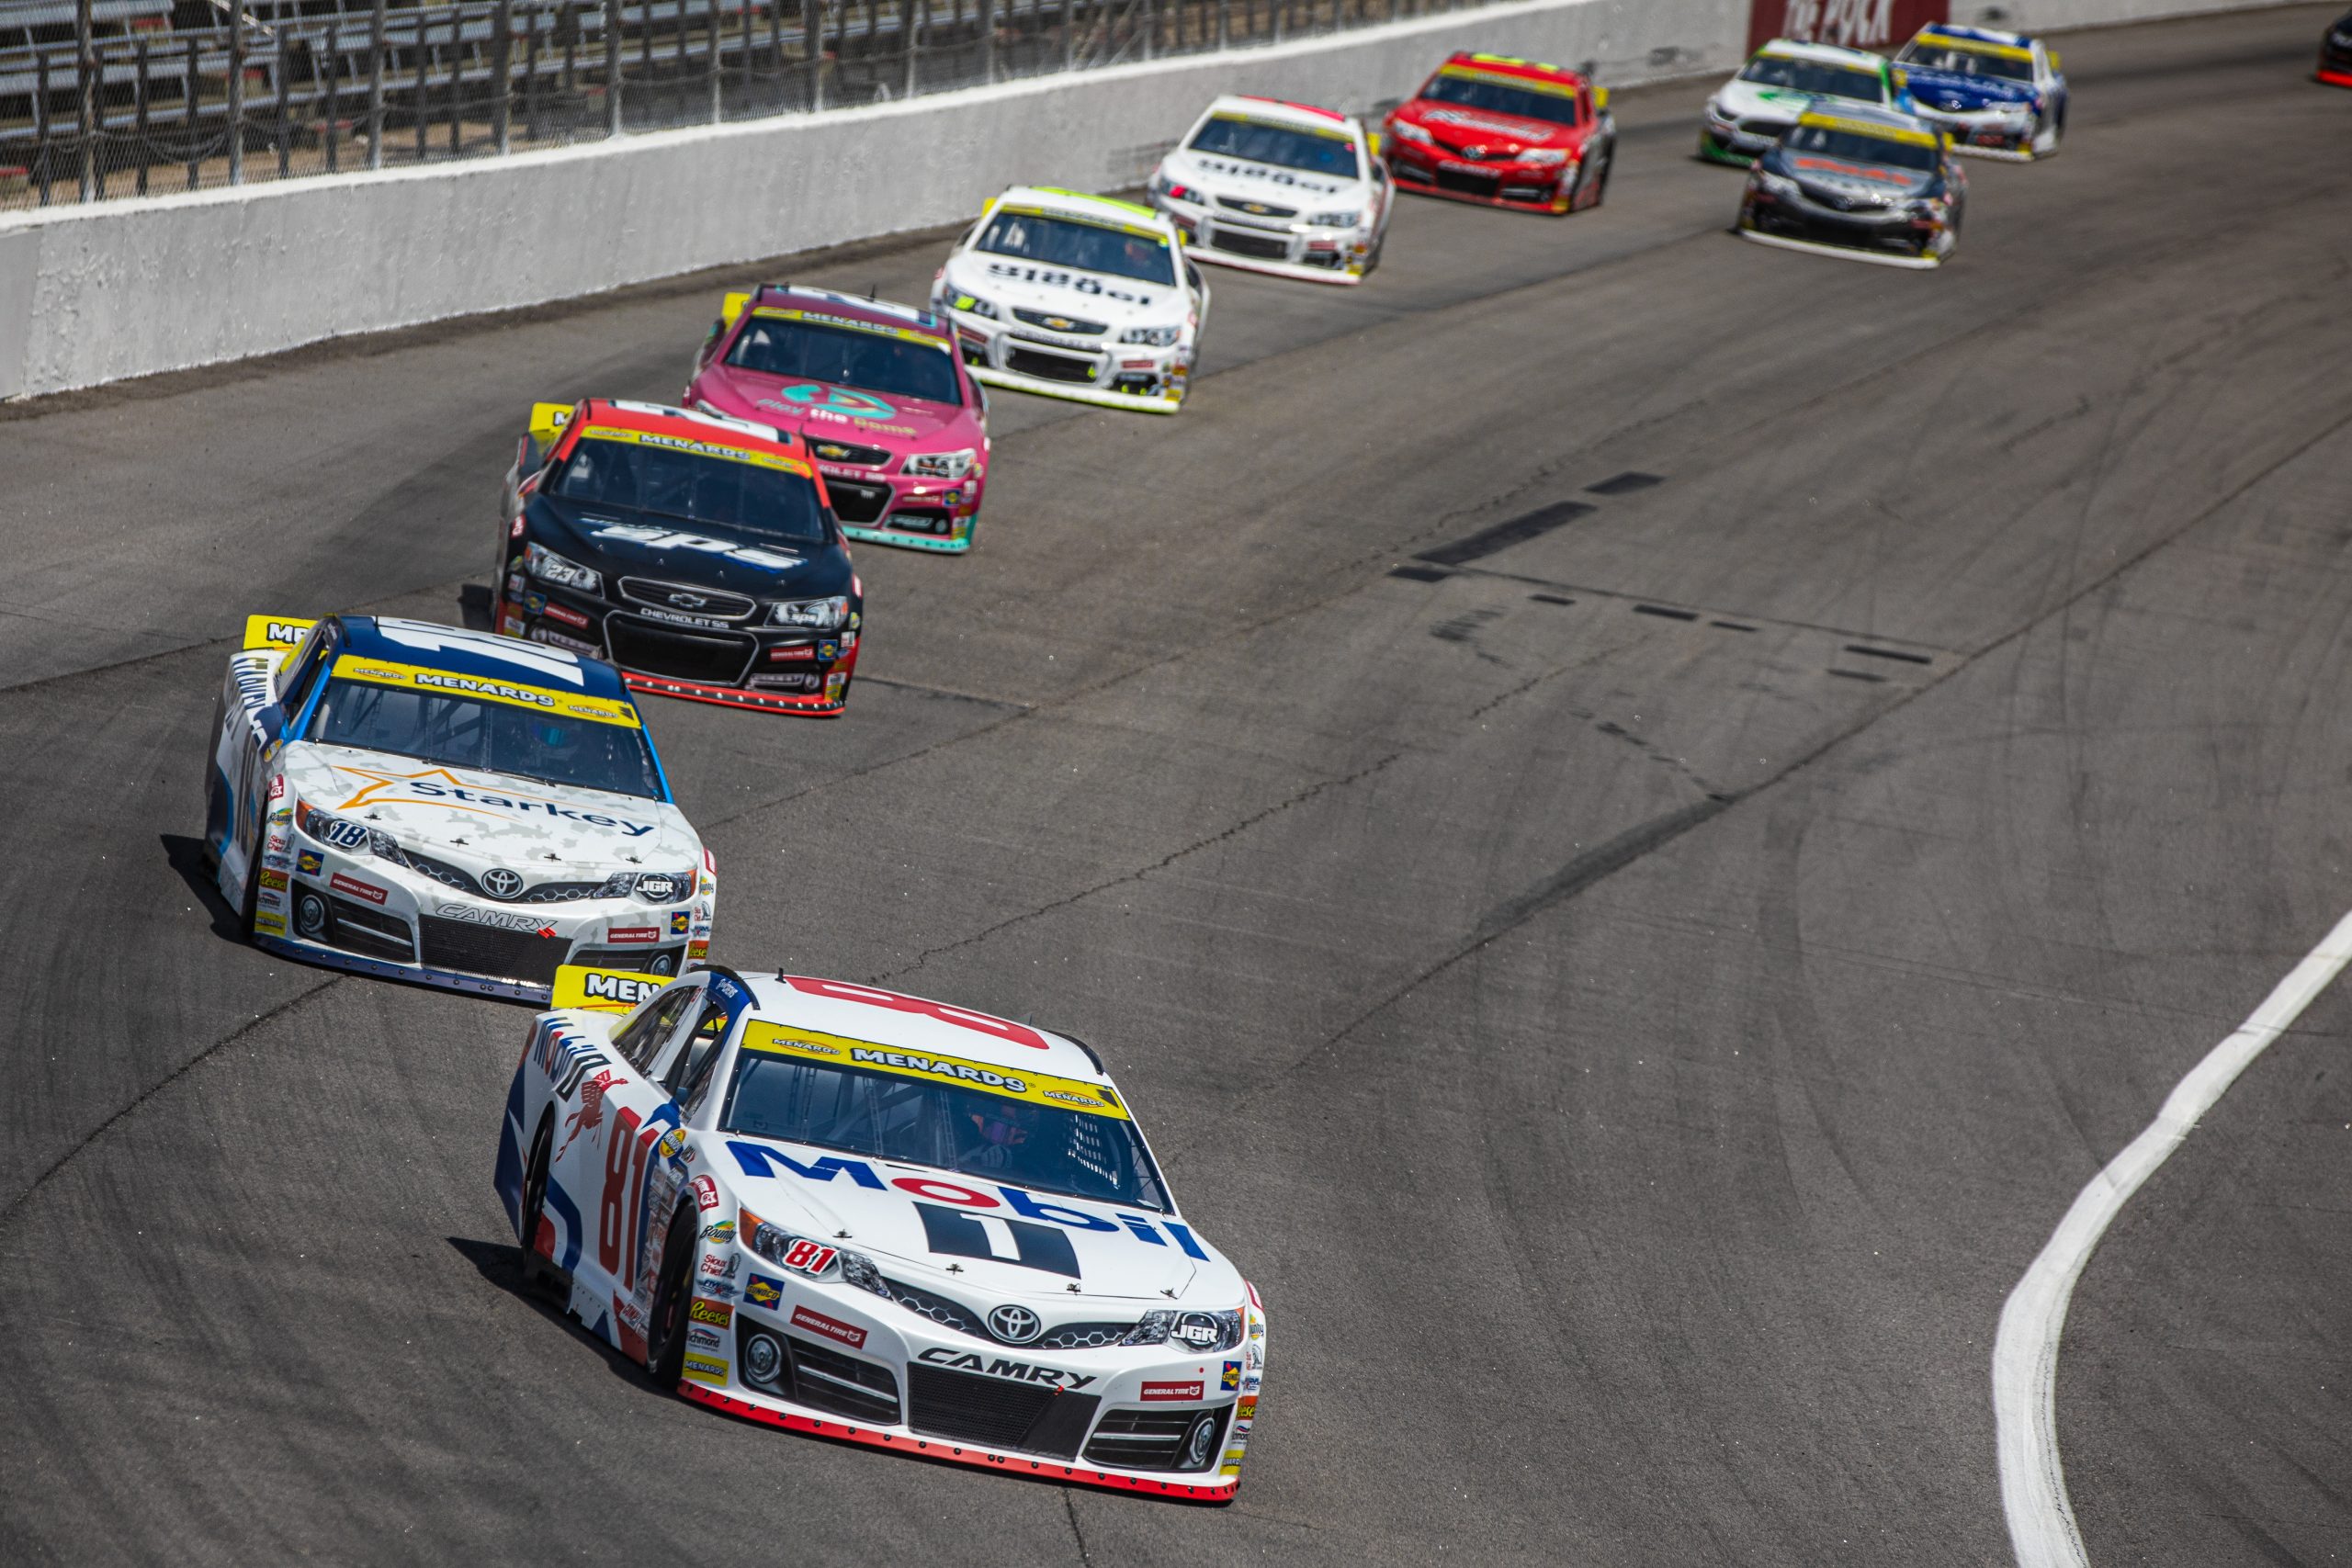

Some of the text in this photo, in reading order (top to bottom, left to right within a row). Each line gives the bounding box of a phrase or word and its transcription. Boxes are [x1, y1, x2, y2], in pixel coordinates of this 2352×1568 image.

[639, 434, 751, 460] MENARDS
[639, 607, 729, 629] CHEVROLET SS
[414, 672, 556, 707] MENARDS
[410, 782, 655, 837] Starkey
[326, 821, 368, 848] 18
[635, 880, 674, 893] JGR
[435, 903, 559, 932] CAMRY
[585, 974, 662, 1002] MEN
[772, 1038, 841, 1055] MENARDS
[852, 1046, 1027, 1093] MENARDS
[1044, 1089, 1105, 1109] MENARDS
[725, 1139, 1211, 1263] Mobil
[698, 1224, 737, 1244] Bounty
[704, 1254, 728, 1268] Sioux
[783, 1240, 838, 1276] 81
[700, 1263, 724, 1277] Chief
[746, 1285, 780, 1301] SUNOCO
[795, 1314, 831, 1331] GENERAL
[830, 1325, 849, 1337] TIRE
[1170, 1323, 1218, 1345] JGR
[684, 1360, 725, 1377] MENARDS
[917, 1347, 1098, 1391] CAMRY
